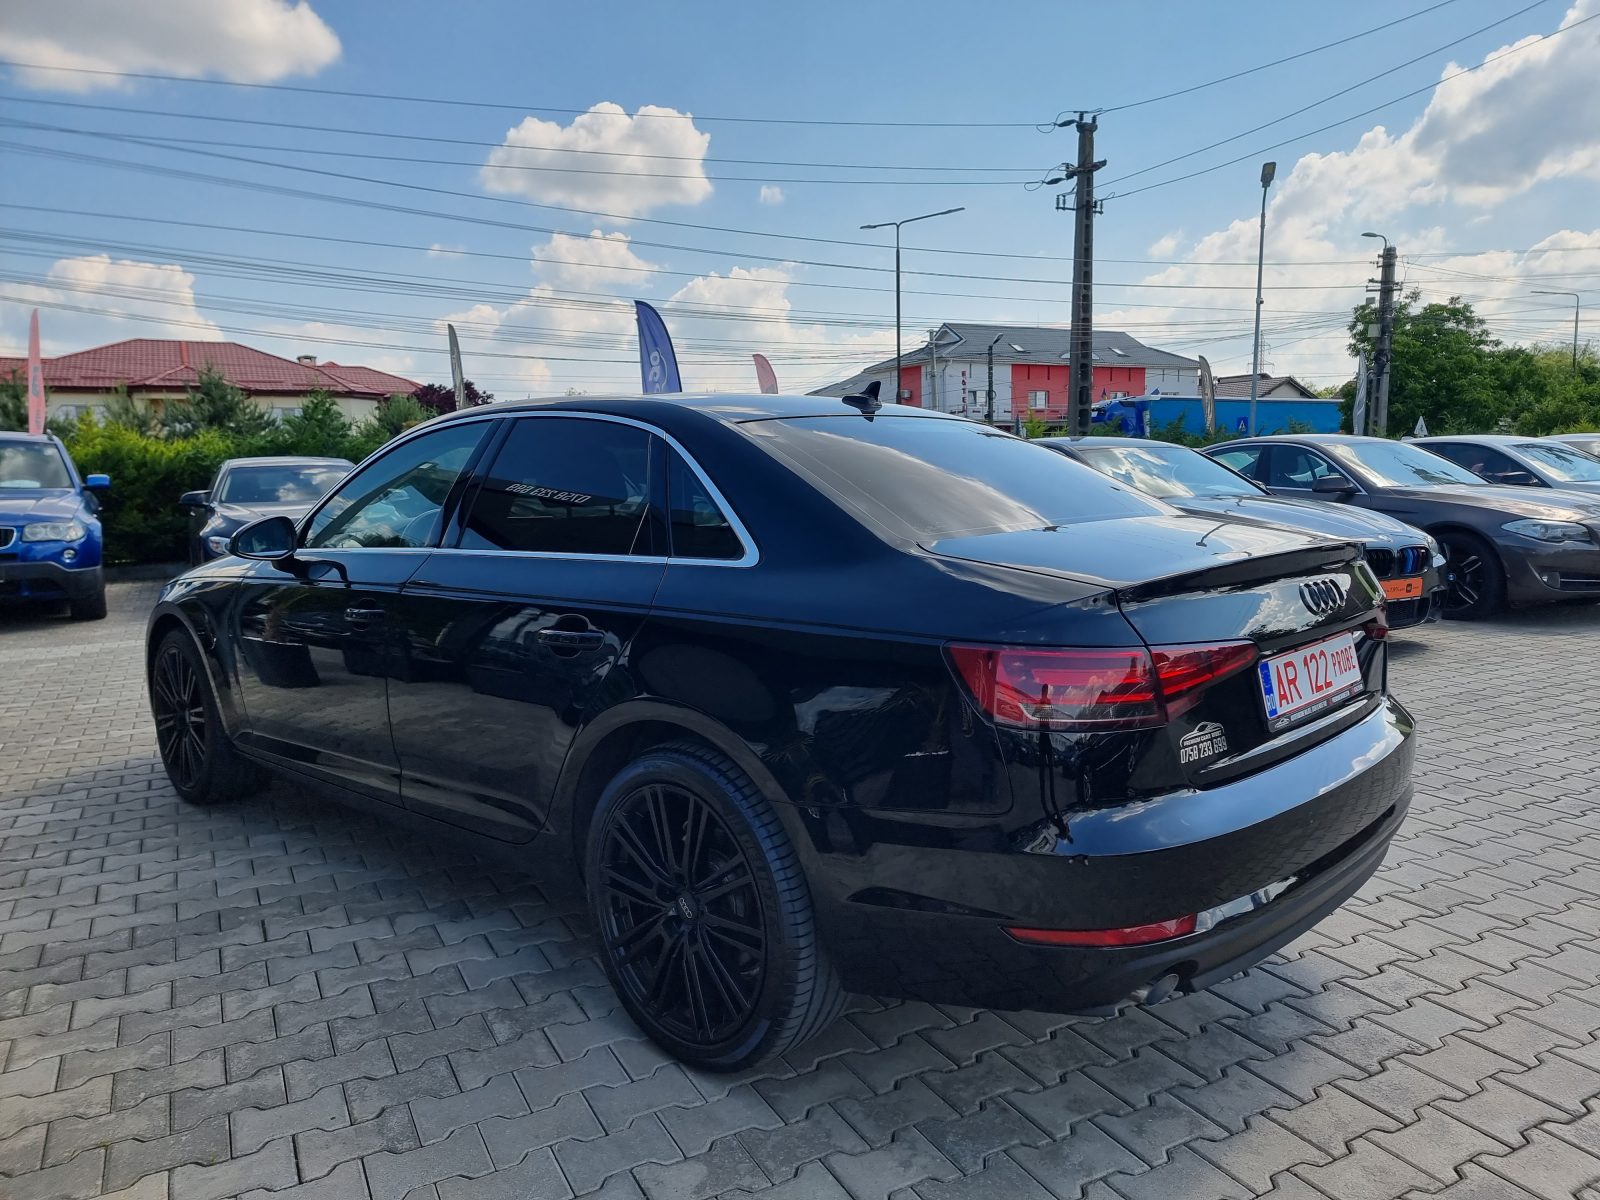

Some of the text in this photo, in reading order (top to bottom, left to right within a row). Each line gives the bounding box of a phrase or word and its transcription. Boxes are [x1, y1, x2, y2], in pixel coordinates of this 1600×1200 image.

[1276, 645, 1356, 707] AR 122 PROBE
[1265, 693, 1277, 712] RO
[1180, 735, 1228, 764] 0758 233 699
